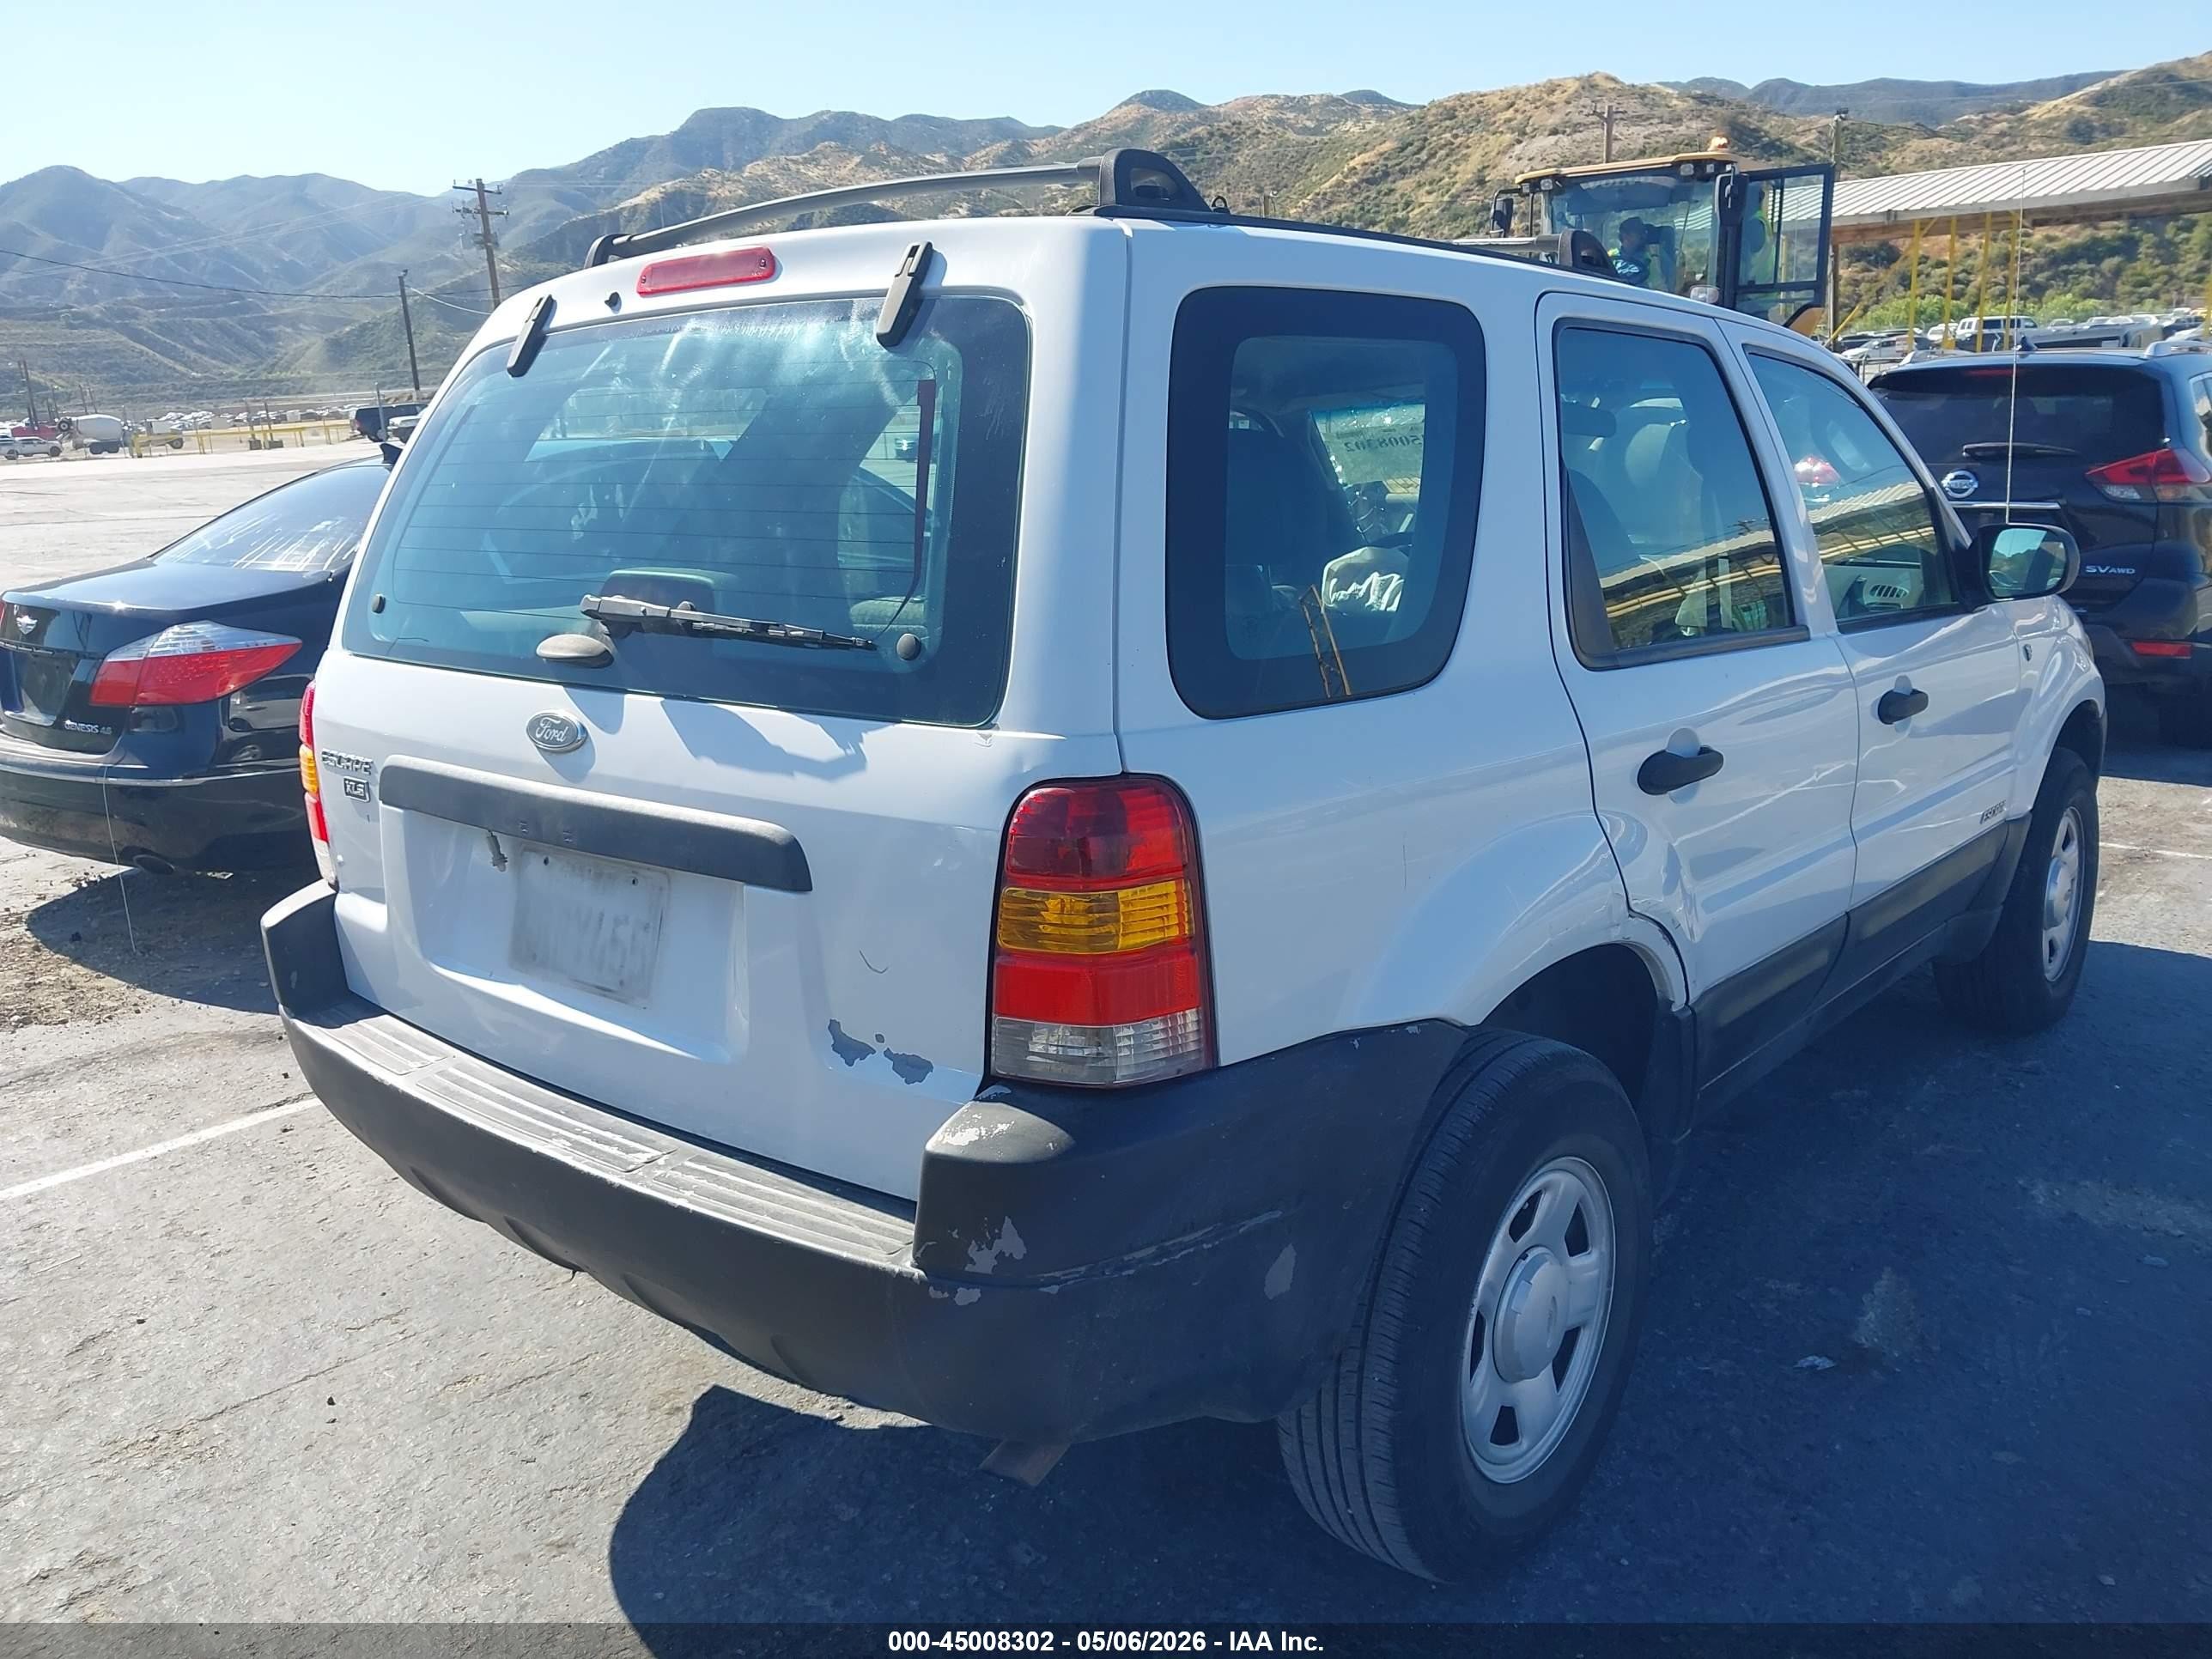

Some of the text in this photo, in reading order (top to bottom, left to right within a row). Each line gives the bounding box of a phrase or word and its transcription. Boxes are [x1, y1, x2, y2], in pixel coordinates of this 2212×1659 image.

[64, 720, 100, 733] GENESIS
[535, 716, 569, 742] Ford
[321, 747, 373, 775] ESCAPE
[344, 780, 365, 797] XLS
